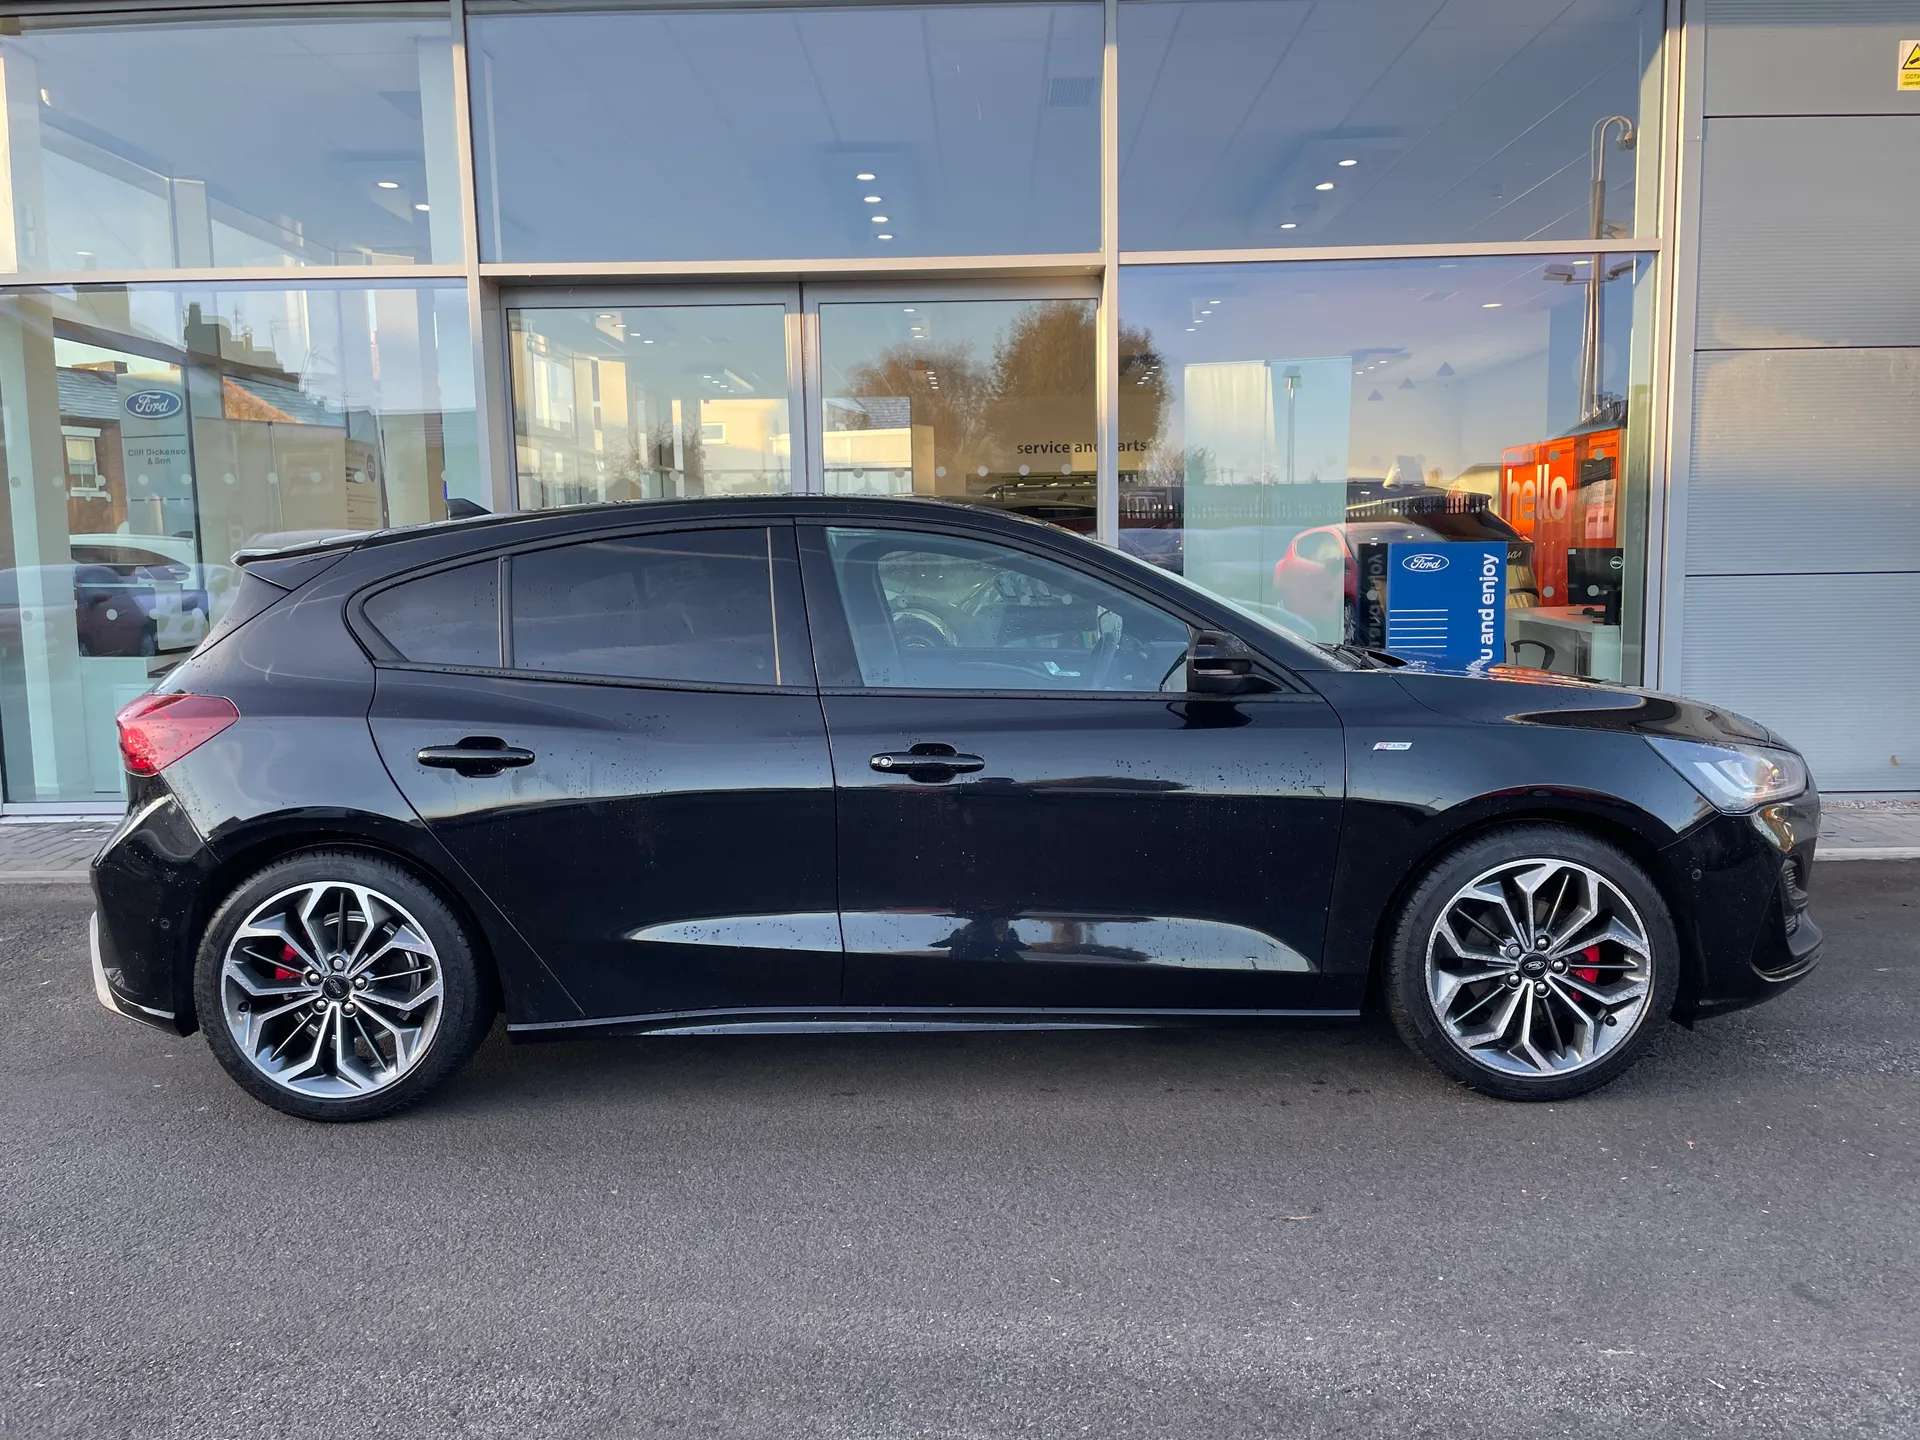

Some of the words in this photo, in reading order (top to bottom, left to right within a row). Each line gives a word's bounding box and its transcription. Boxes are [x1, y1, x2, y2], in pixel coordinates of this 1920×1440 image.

[135, 393, 171, 413] Ford
[1016, 440, 1071, 454] service
[1118, 439, 1147, 452] arts
[1507, 464, 1568, 522] hello
[1410, 555, 1442, 570] Ford
[1479, 553, 1499, 605] enjoy
[1478, 608, 1494, 645] and
